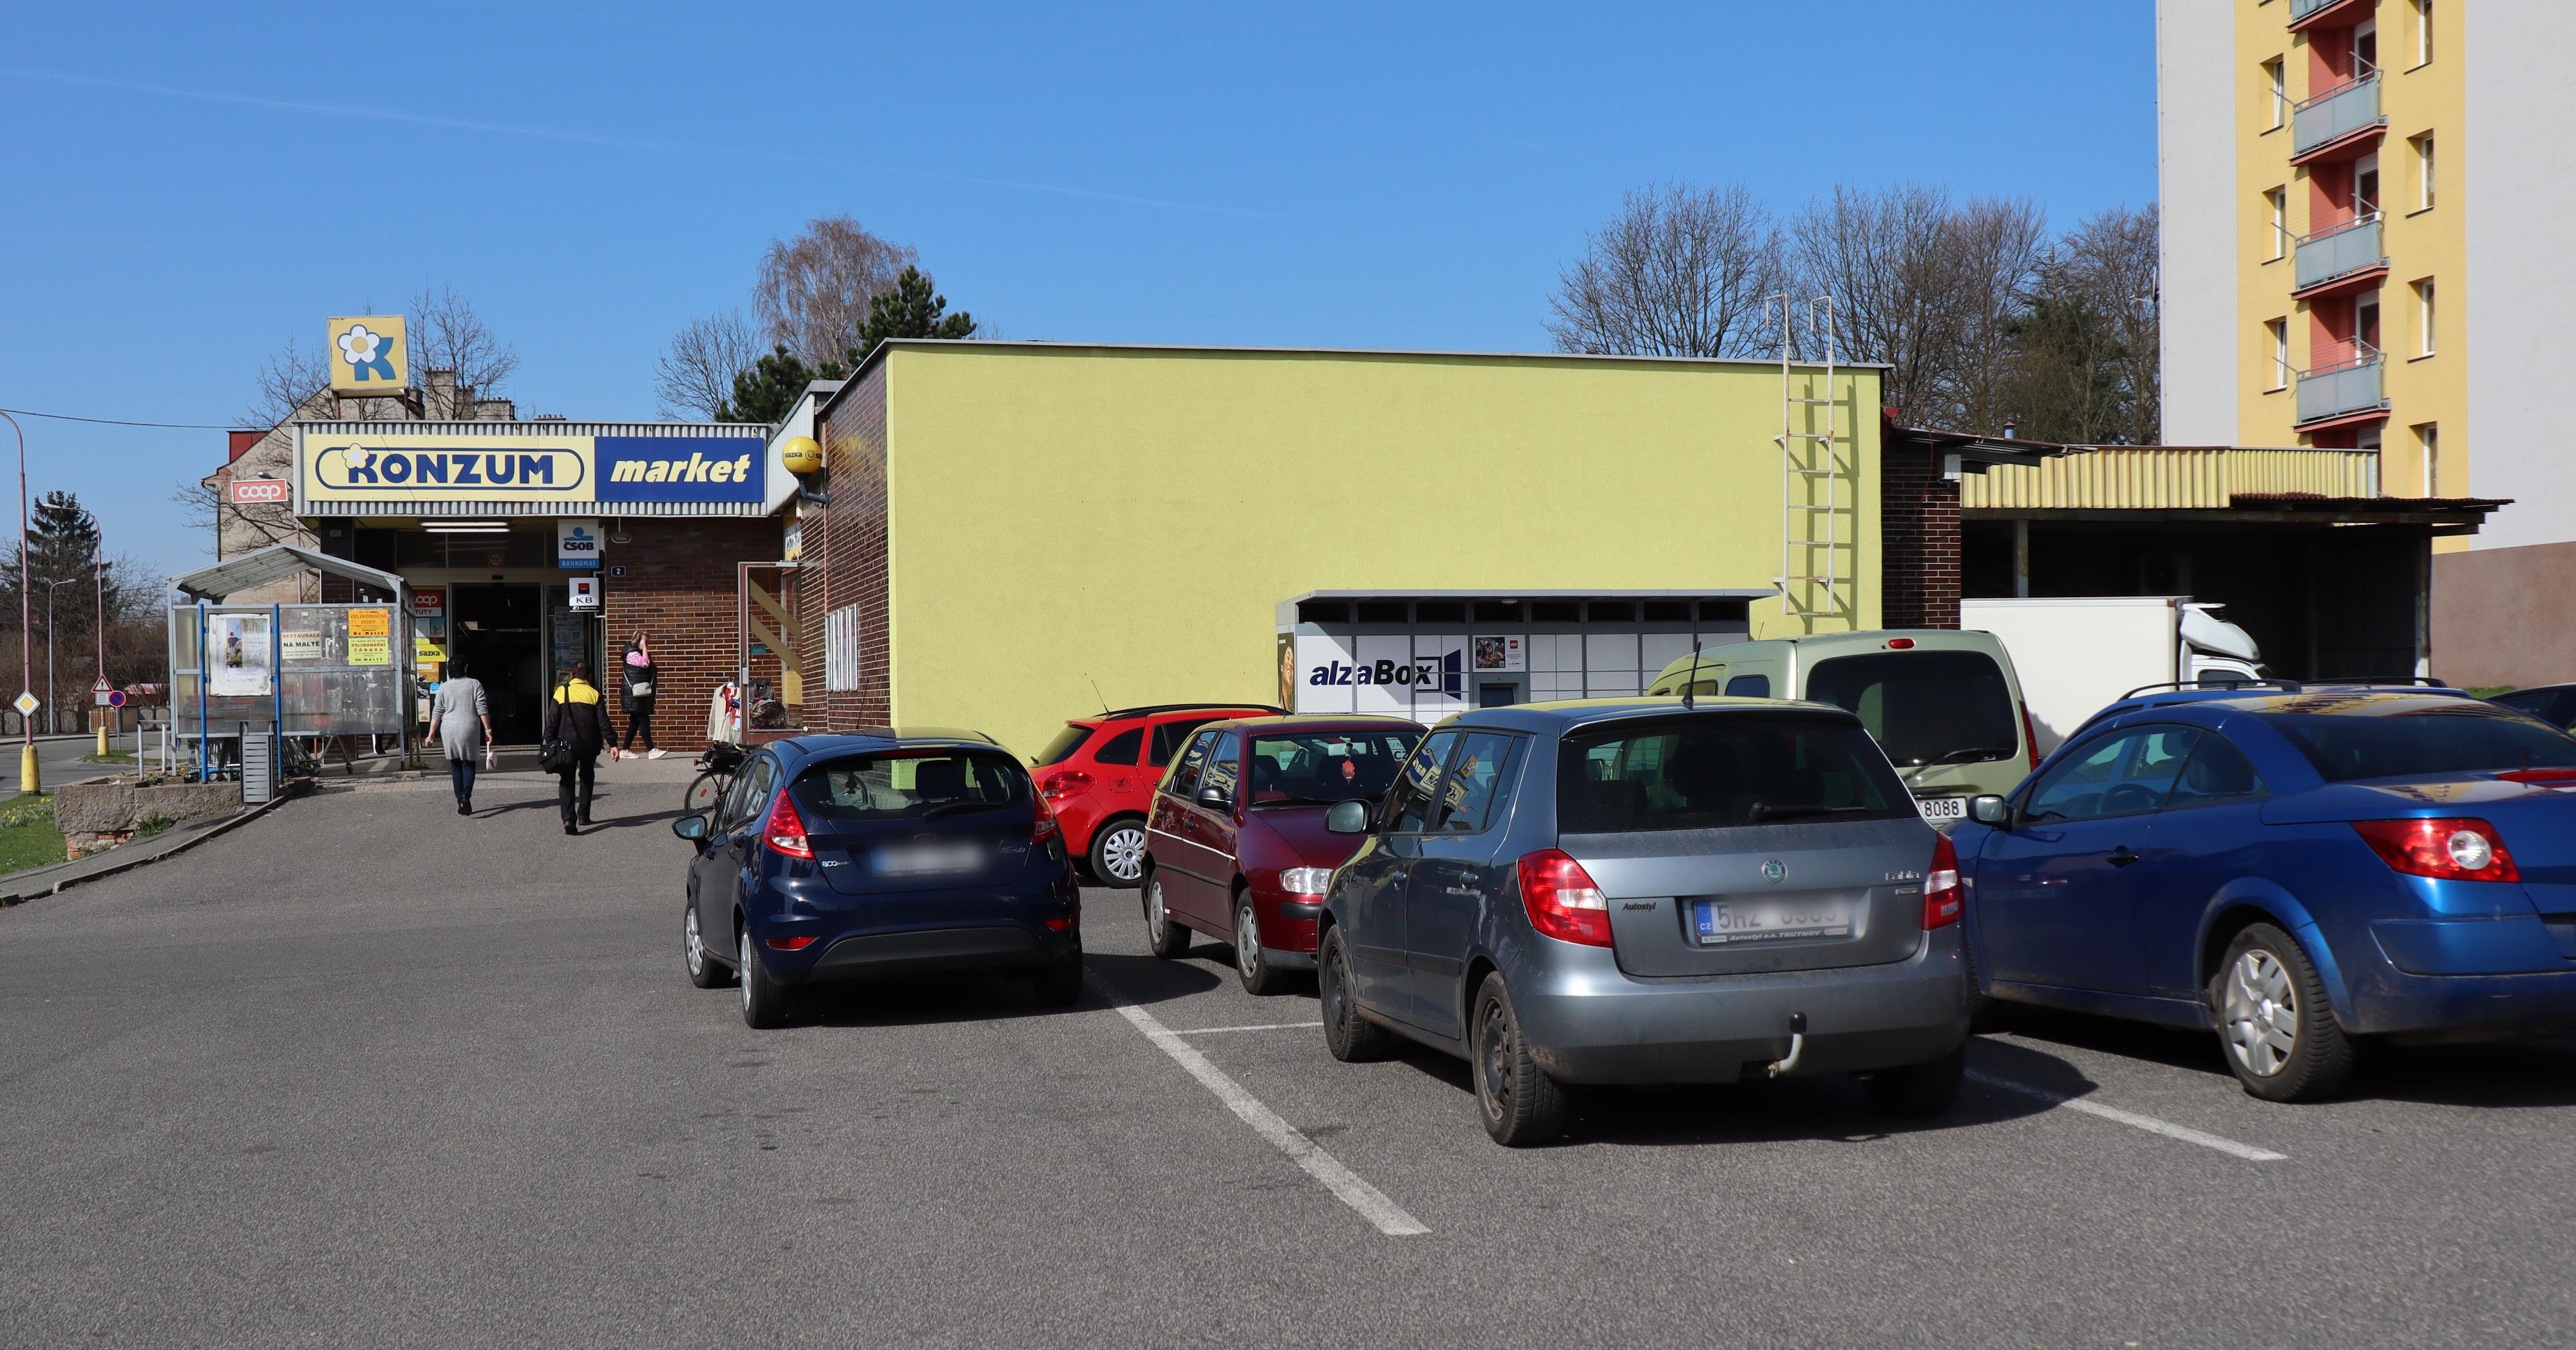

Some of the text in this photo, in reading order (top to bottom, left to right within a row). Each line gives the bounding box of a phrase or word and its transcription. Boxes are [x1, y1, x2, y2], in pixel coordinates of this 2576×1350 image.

[348, 453, 554, 484] KONZUM
[610, 452, 751, 482] market
[238, 484, 281, 500] coop
[564, 542, 594, 551] ČSOB
[415, 596, 438, 605] oop
[1309, 660, 1433, 685] alzaBox
[1924, 801, 1959, 817] 8088
[1623, 902, 1656, 912] Autostyl
